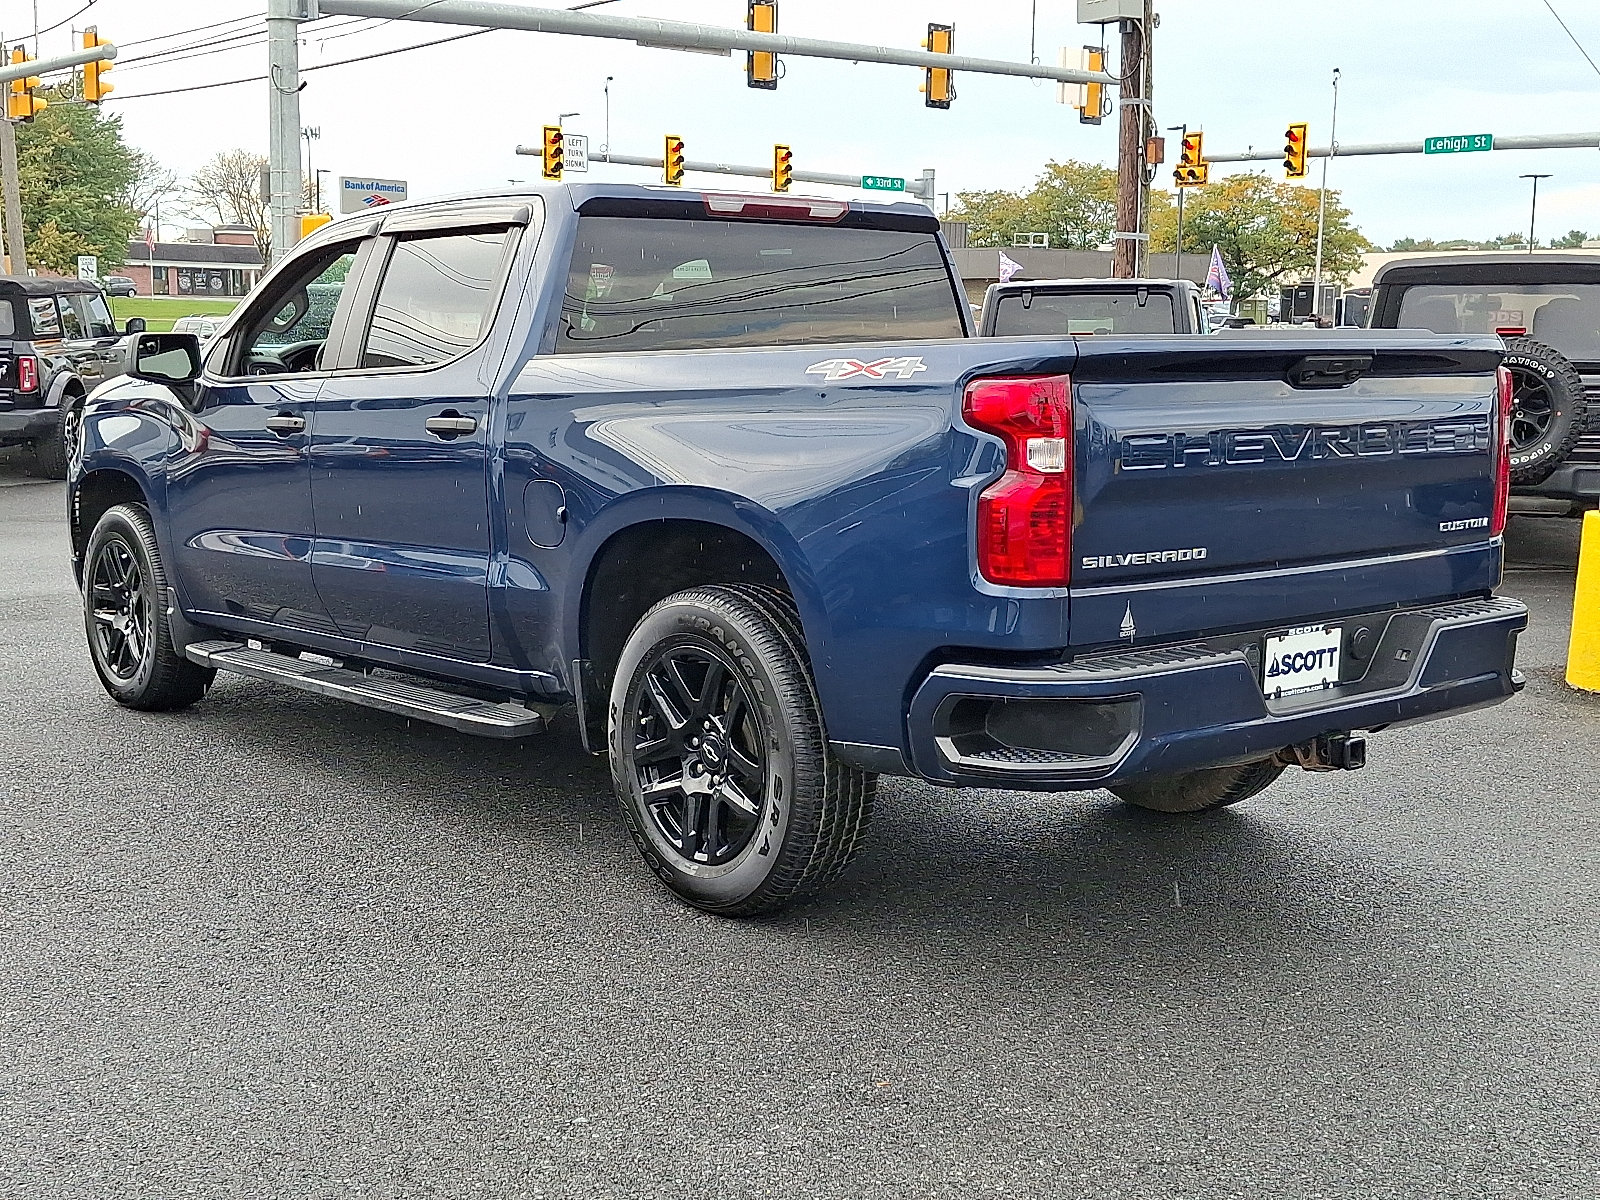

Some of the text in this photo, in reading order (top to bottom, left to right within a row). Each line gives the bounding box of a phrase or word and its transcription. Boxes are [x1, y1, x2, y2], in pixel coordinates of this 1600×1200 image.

[568, 139, 582, 147] LEFT
[1430, 136, 1486, 151] Lehigh St
[568, 149, 583, 157] TURN
[565, 160, 585, 168] SIGNAL
[345, 180, 405, 193] Bank of America
[876, 178, 902, 189] 33rd St
[1440, 517, 1489, 532] CUSTOM
[1082, 548, 1207, 569] SILVERADO
[1120, 628, 1137, 638] SCOTT
[1288, 624, 1325, 636] SCOTT
[1280, 646, 1339, 675] SCOTT
[676, 612, 783, 752] WRANGLER
